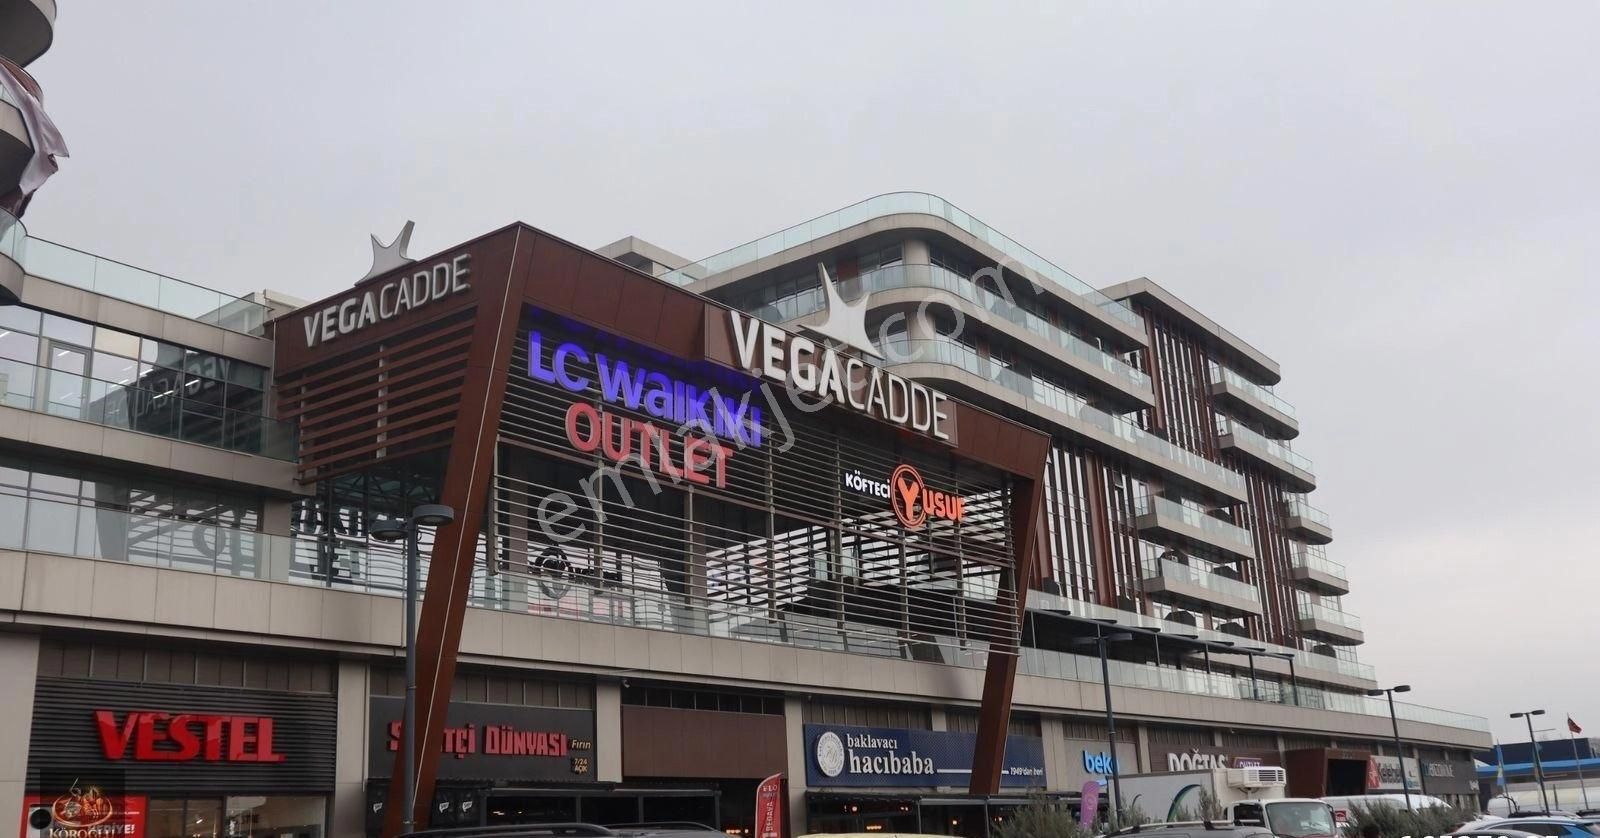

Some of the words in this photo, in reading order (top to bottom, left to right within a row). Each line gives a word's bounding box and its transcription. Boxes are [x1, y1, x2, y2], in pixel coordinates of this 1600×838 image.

[303, 253, 471, 347] VEGACADDE
[528, 331, 590, 392] LC
[729, 310, 949, 440] VEGACADDE
[565, 402, 733, 489] OUTLET
[845, 469, 891, 498] KÖFTECİ
[94, 710, 287, 763] VESTEL
[386, 720, 476, 759] STÇİ
[484, 724, 567, 757] DÜNYASI
[847, 733, 898, 749] baklavacı
[848, 749, 935, 775] hacıbaba
